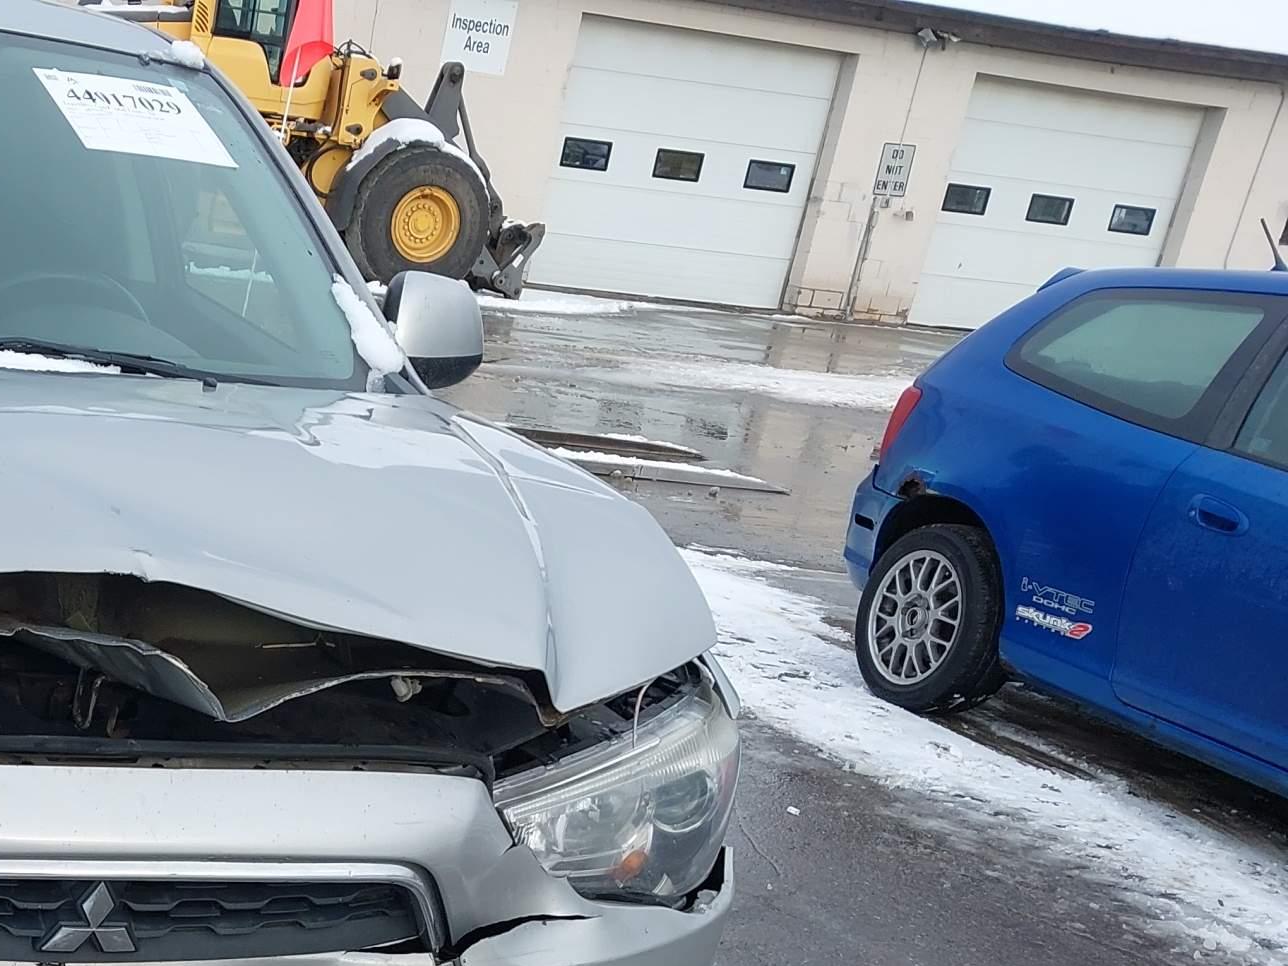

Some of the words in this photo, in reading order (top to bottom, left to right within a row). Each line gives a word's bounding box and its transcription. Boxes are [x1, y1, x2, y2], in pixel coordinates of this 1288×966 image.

[451, 12, 510, 37] Inspection
[463, 35, 490, 54] Area
[67, 88, 182, 115] 44017029
[891, 148, 905, 160] DO
[885, 164, 905, 176] NOT
[1031, 595, 1077, 616] DOHC
